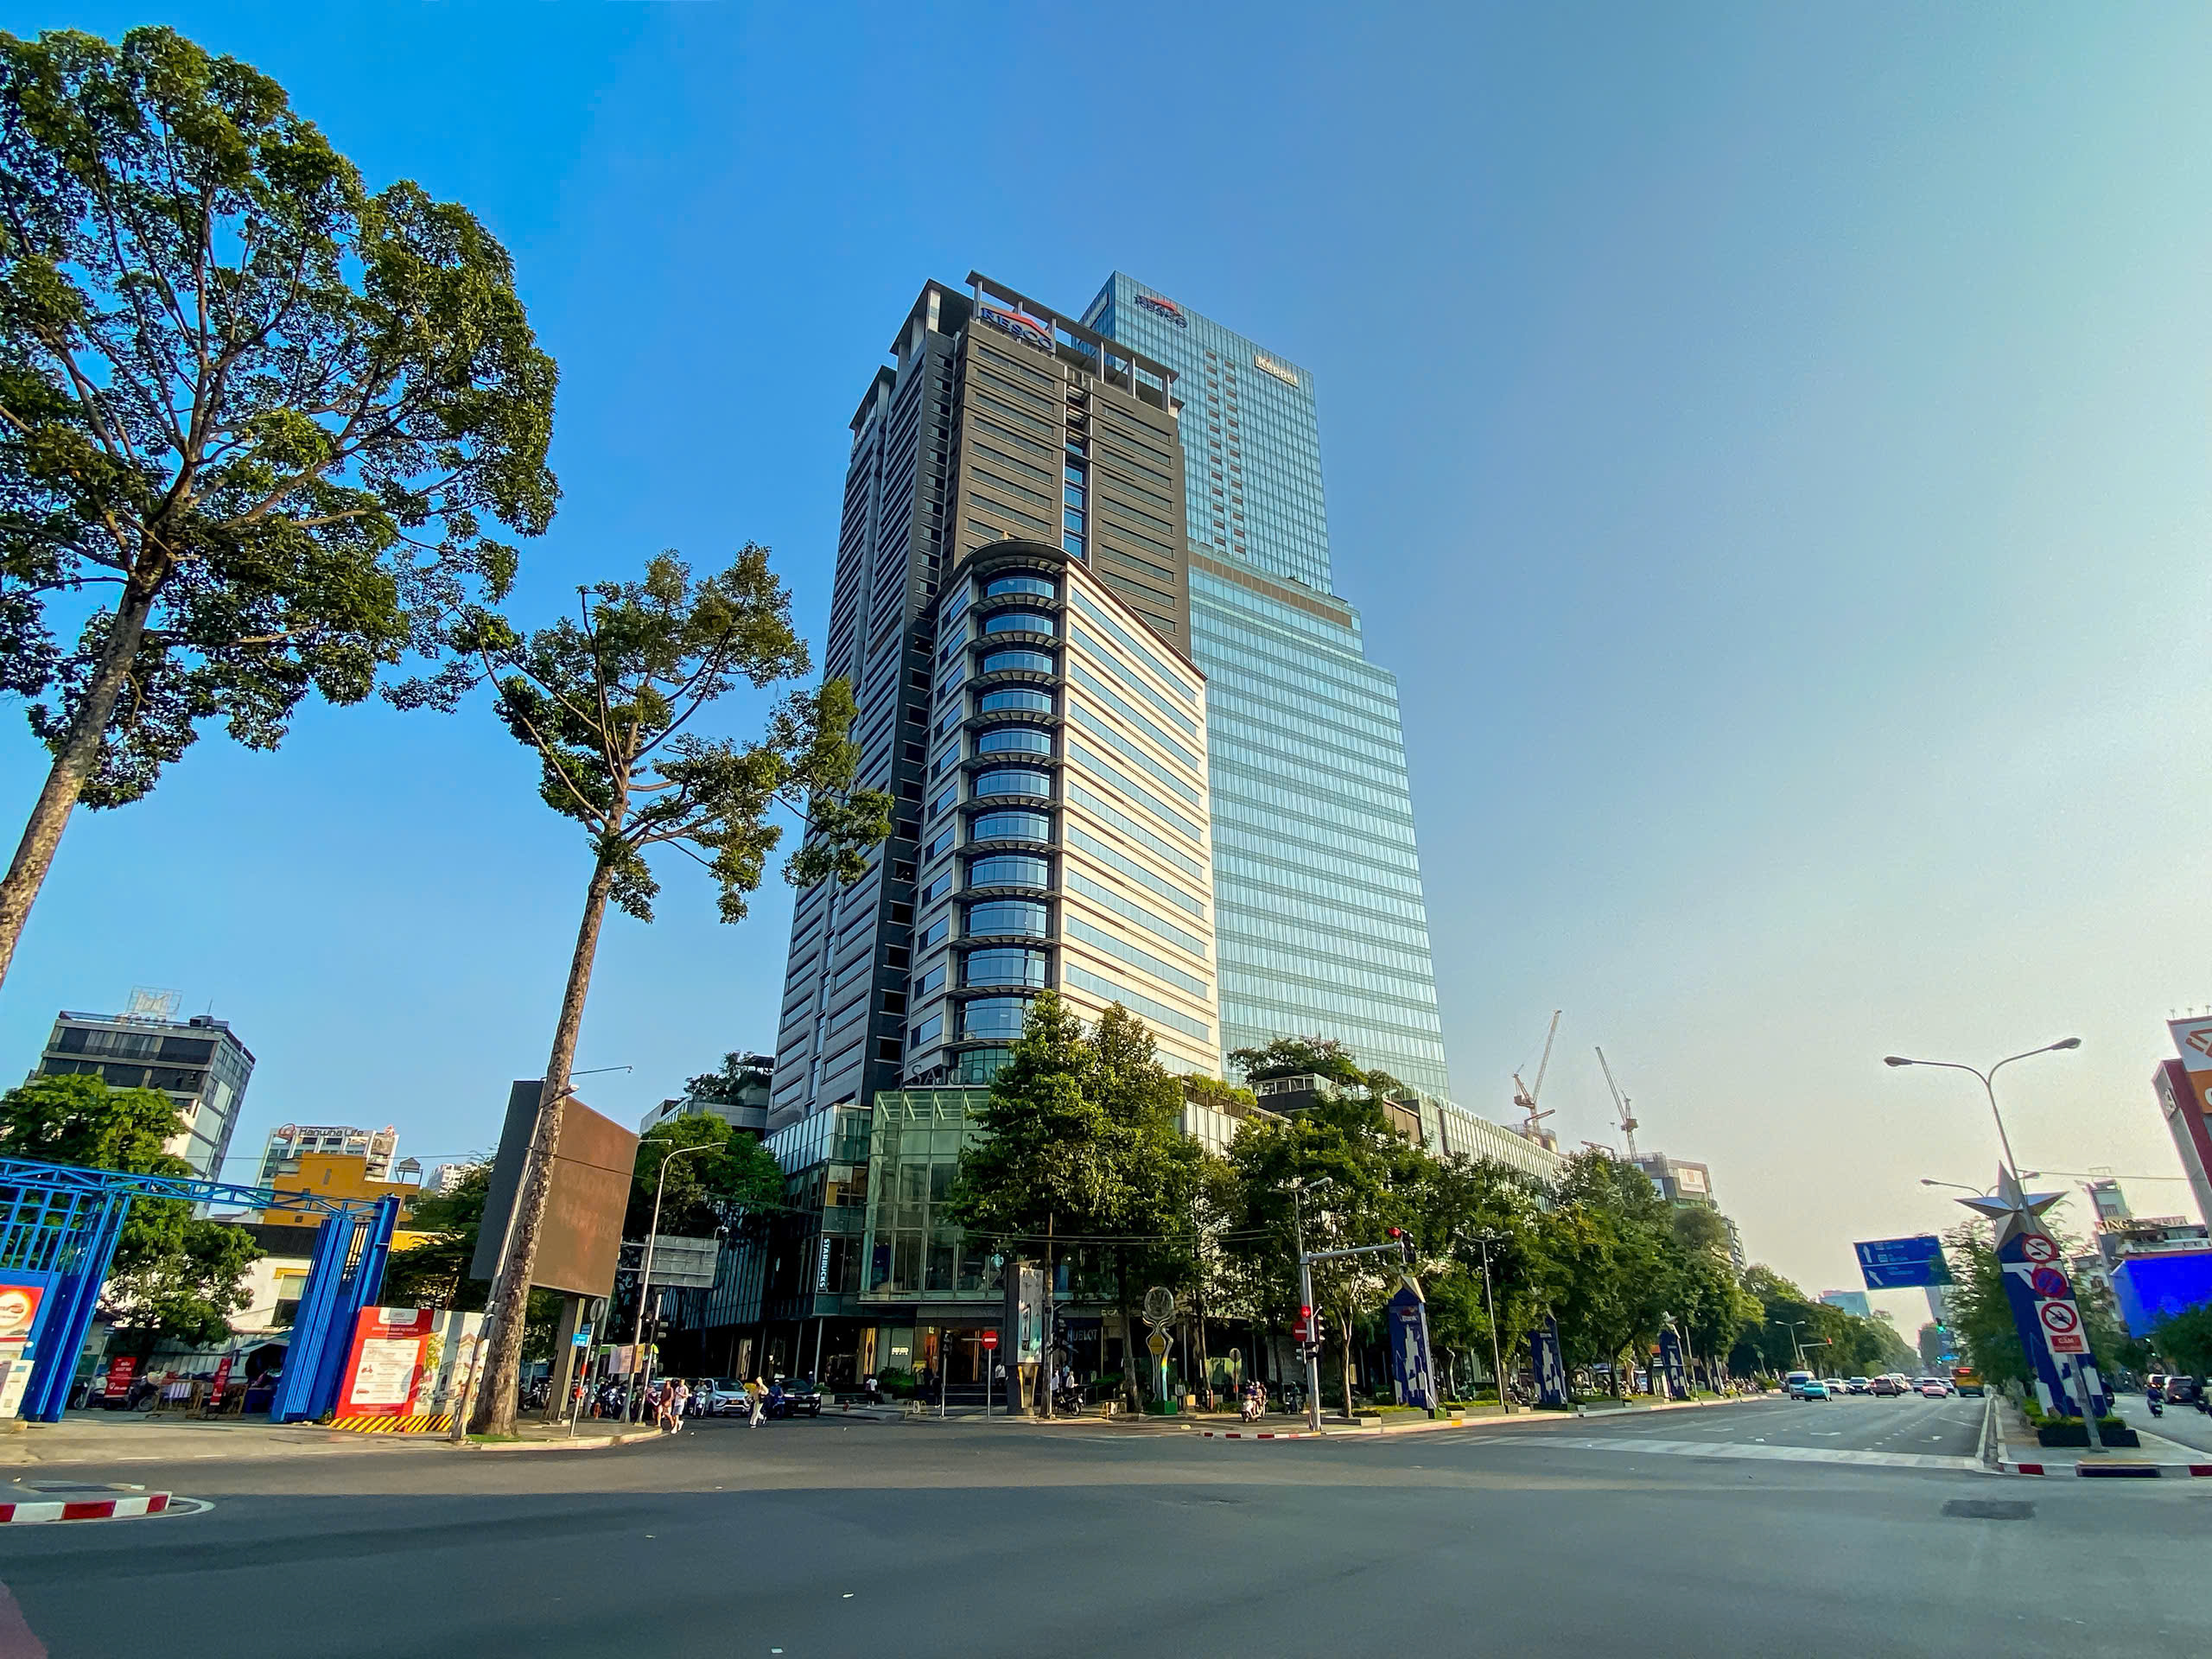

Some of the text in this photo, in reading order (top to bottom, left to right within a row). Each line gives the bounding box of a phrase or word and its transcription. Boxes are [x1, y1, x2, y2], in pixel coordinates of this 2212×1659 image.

[1256, 355, 1299, 385] Keppel
[298, 1128, 365, 1136] Hanwha Life
[819, 1238, 830, 1287] STARBUCKS
[1067, 1329, 1097, 1341] HUBLOT
